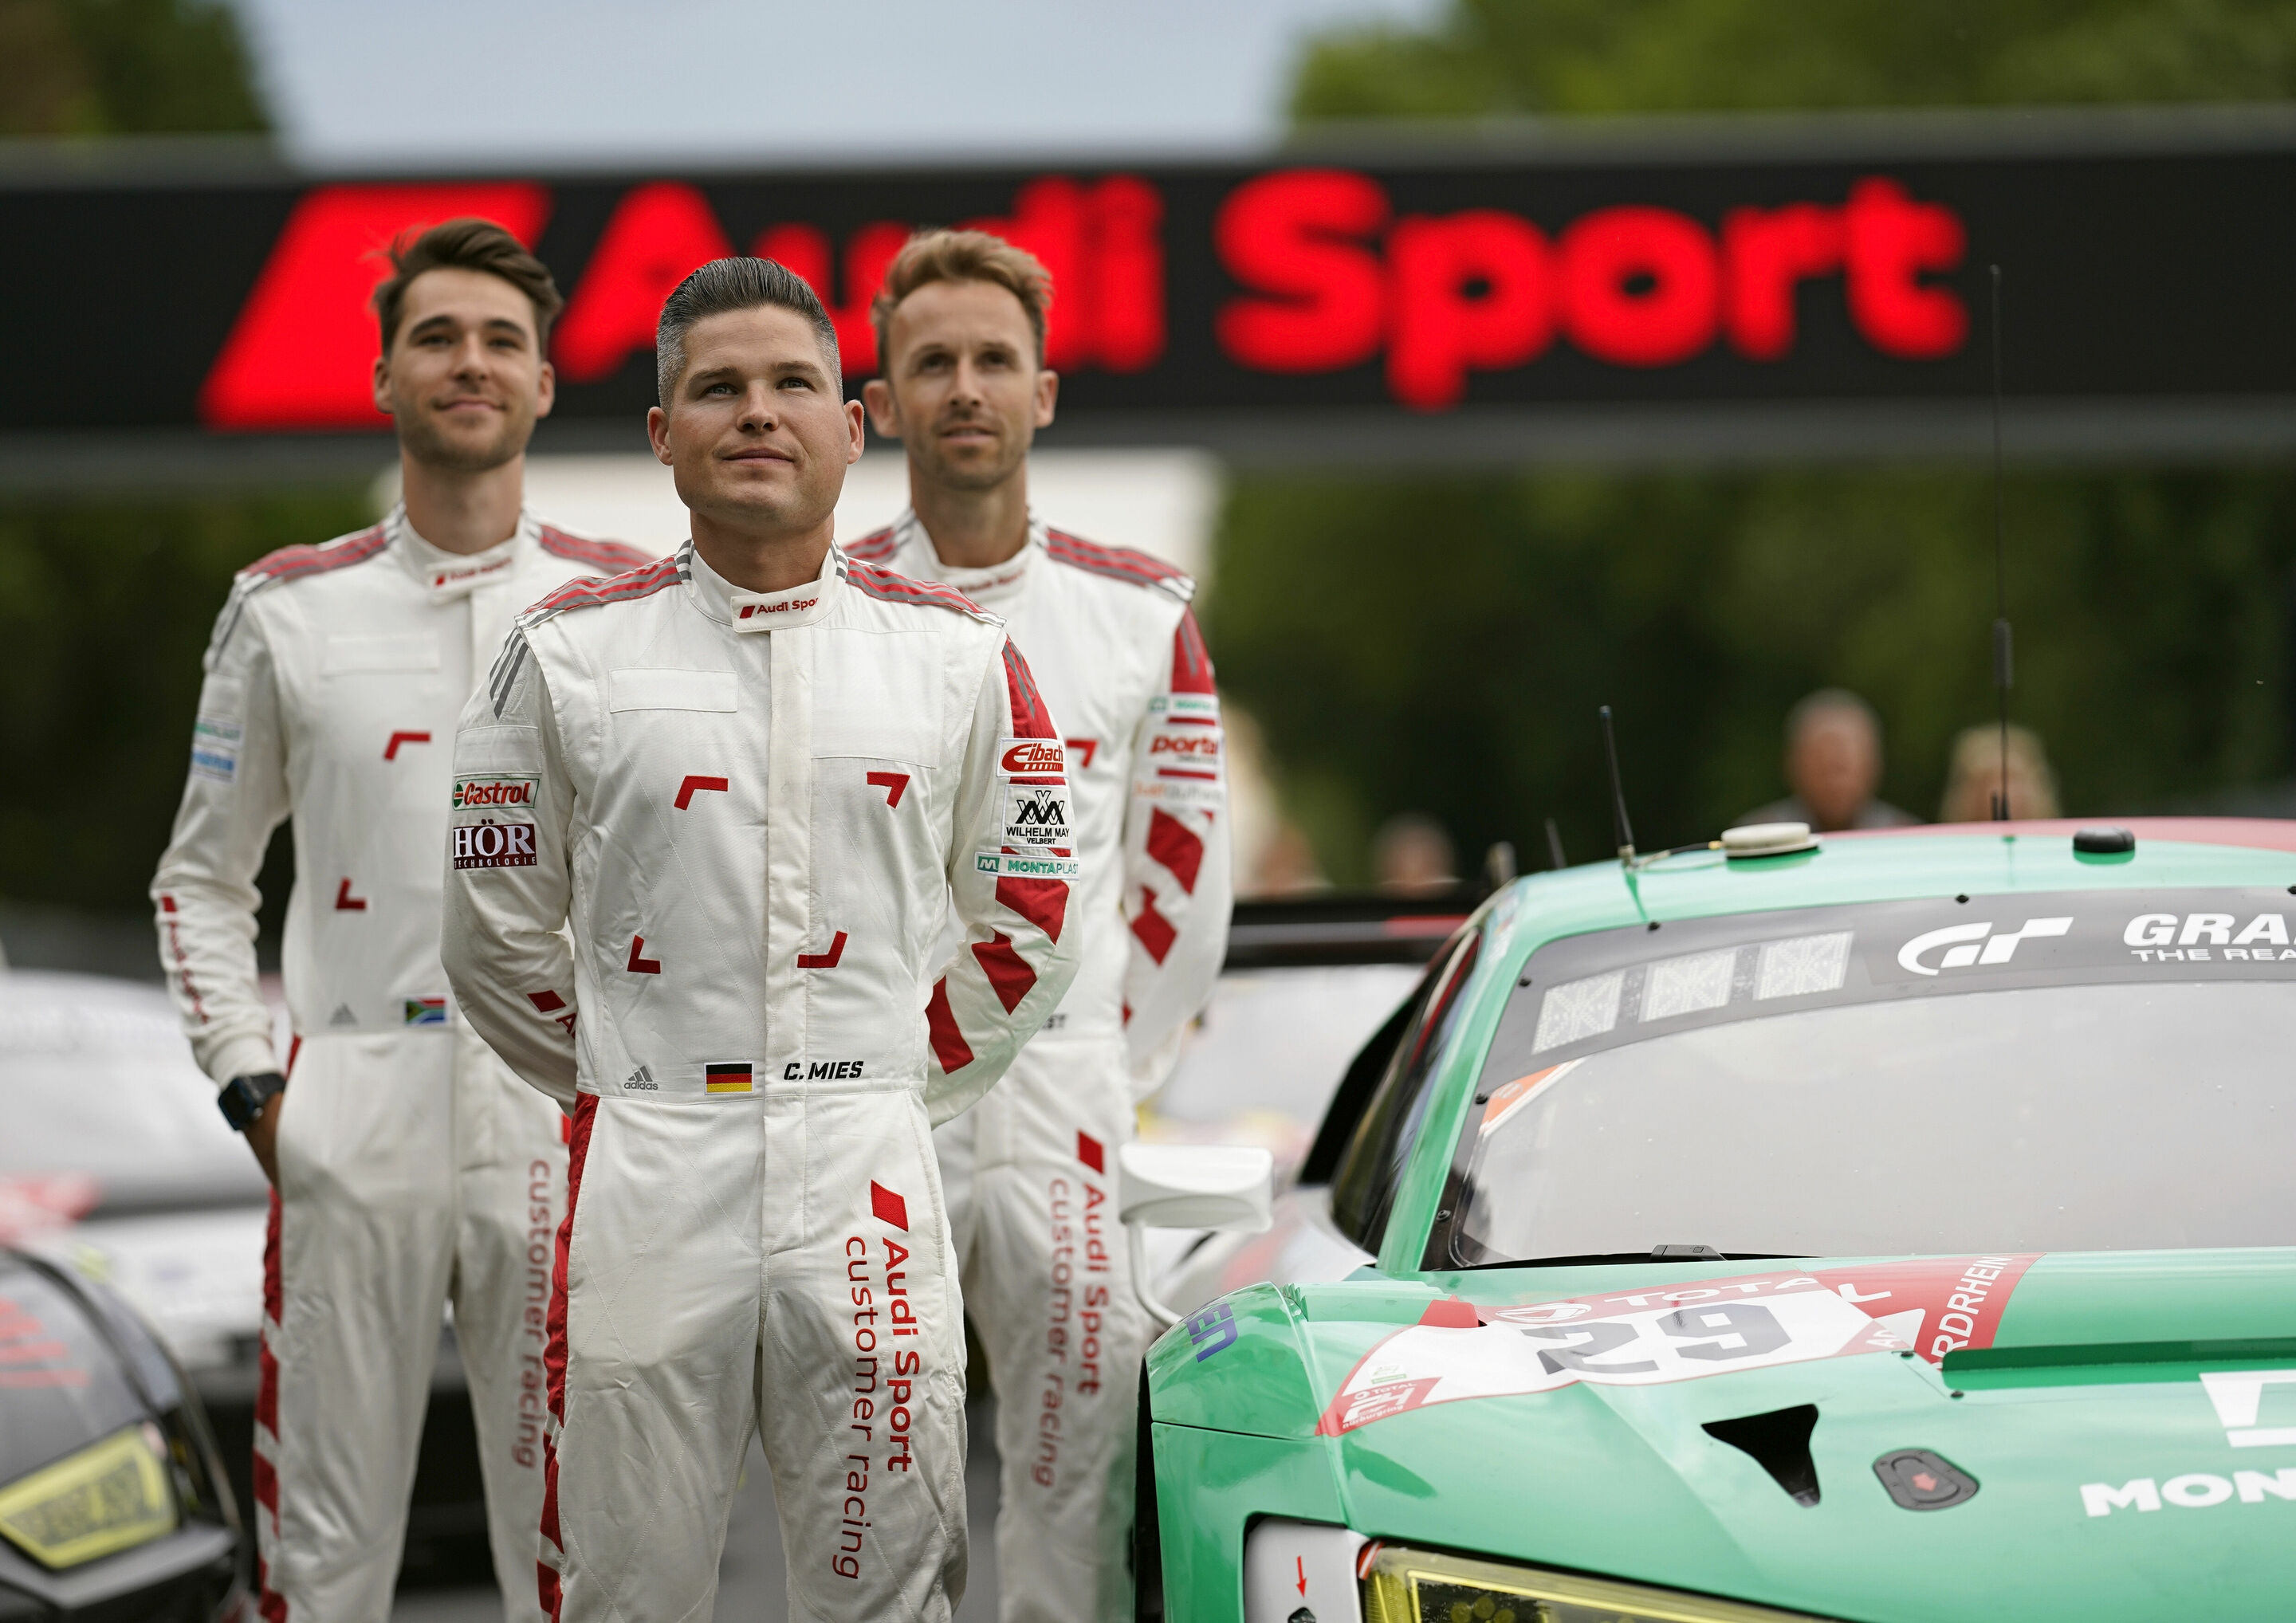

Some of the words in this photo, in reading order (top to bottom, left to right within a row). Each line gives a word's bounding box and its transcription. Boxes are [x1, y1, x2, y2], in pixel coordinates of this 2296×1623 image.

[1214, 167, 1968, 413] Sport
[757, 602, 788, 614] Audi
[1001, 742, 1063, 772] Eibach
[464, 782, 531, 805] Castrol
[454, 819, 535, 859] HÖR
[454, 856, 536, 869] TECHNOLOGIE
[1006, 827, 1052, 837] WILHELM
[1055, 827, 1070, 838] MAY
[2124, 914, 2296, 946] GRA
[2131, 949, 2211, 961] THE
[623, 1080, 659, 1091] adidas
[808, 1061, 864, 1080] MIES
[523, 1159, 551, 1345] customer
[1082, 1181, 1111, 1272] Audi
[883, 1236, 919, 1335] Audi
[1047, 1177, 1072, 1365] customer
[846, 1236, 879, 1441] customer
[1077, 1284, 1110, 1397] Sport
[1520, 1303, 1792, 1375] 29
[512, 1352, 545, 1470] racing
[887, 1350, 920, 1472] Sport
[1371, 1382, 1417, 1393] TOTAL
[1032, 1373, 1063, 1488] racing
[832, 1453, 874, 1579] racing
[2079, 1468, 2296, 1517] MON
